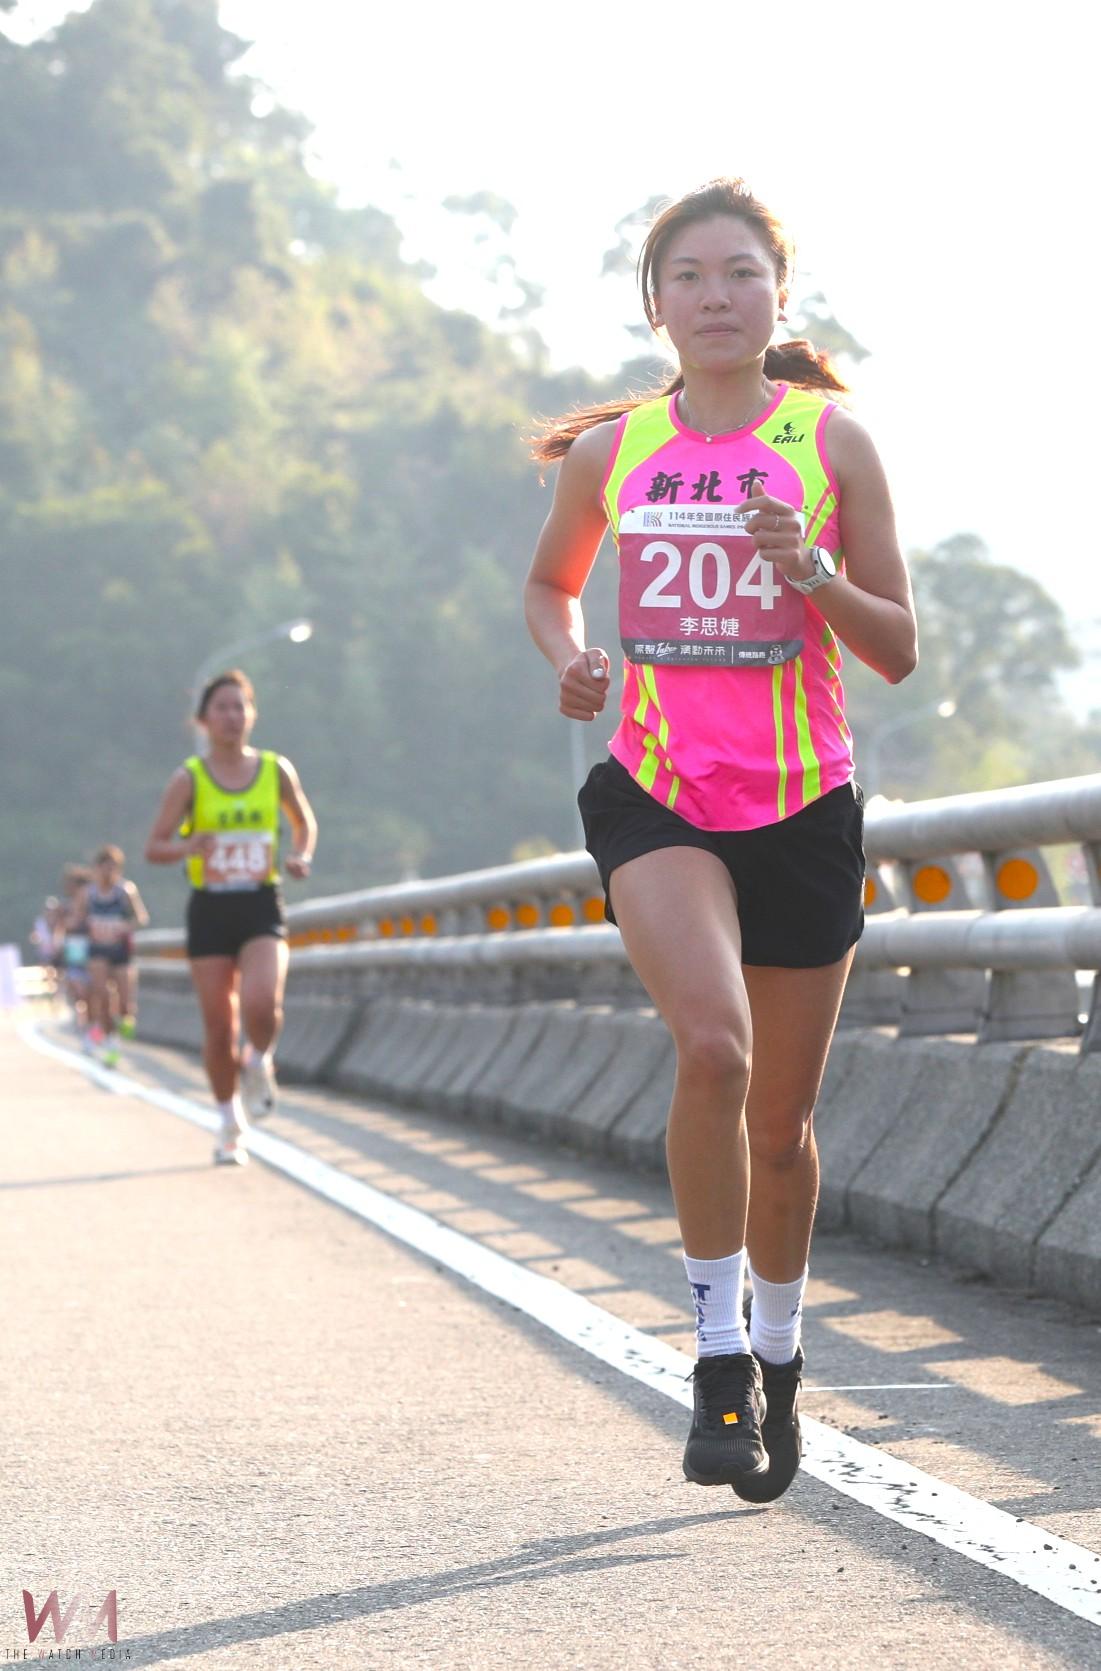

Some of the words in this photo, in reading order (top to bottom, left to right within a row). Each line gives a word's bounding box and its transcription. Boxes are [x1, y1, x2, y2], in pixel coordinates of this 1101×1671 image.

[645, 468, 769, 504] 新北市
[668, 511, 755, 523] 114年全國原住民族
[639, 541, 782, 610] 204
[679, 616, 740, 637] 李思婕
